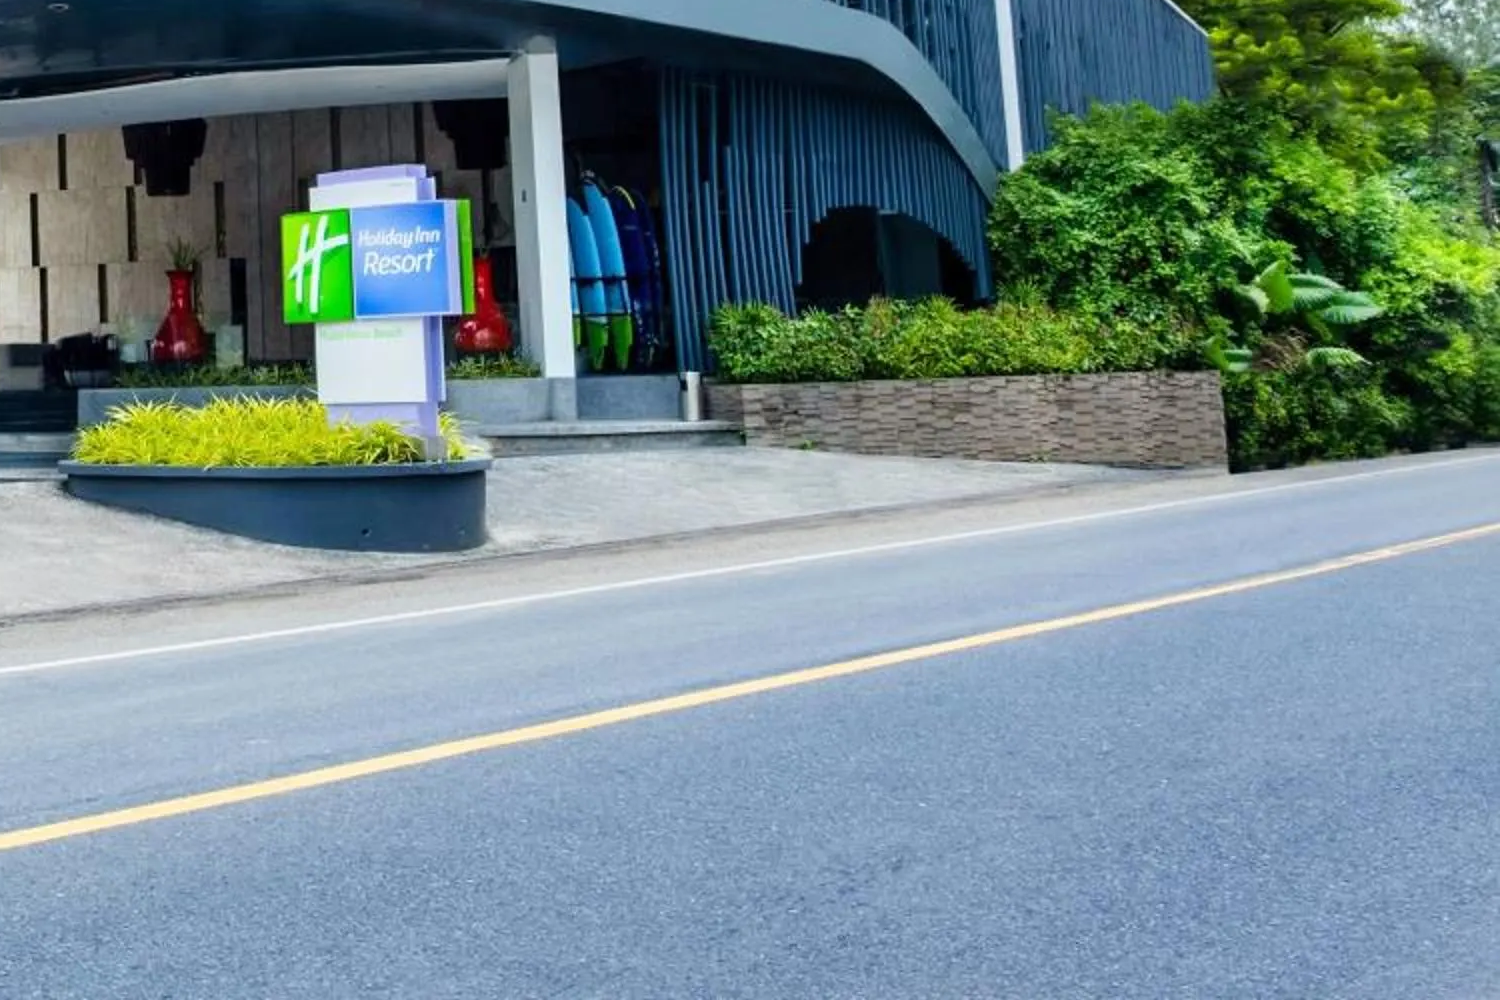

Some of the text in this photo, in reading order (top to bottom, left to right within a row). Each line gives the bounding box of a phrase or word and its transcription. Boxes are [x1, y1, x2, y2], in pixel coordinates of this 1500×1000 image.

[357, 225, 441, 248] Holiday Inn
[363, 248, 435, 277] Resort
